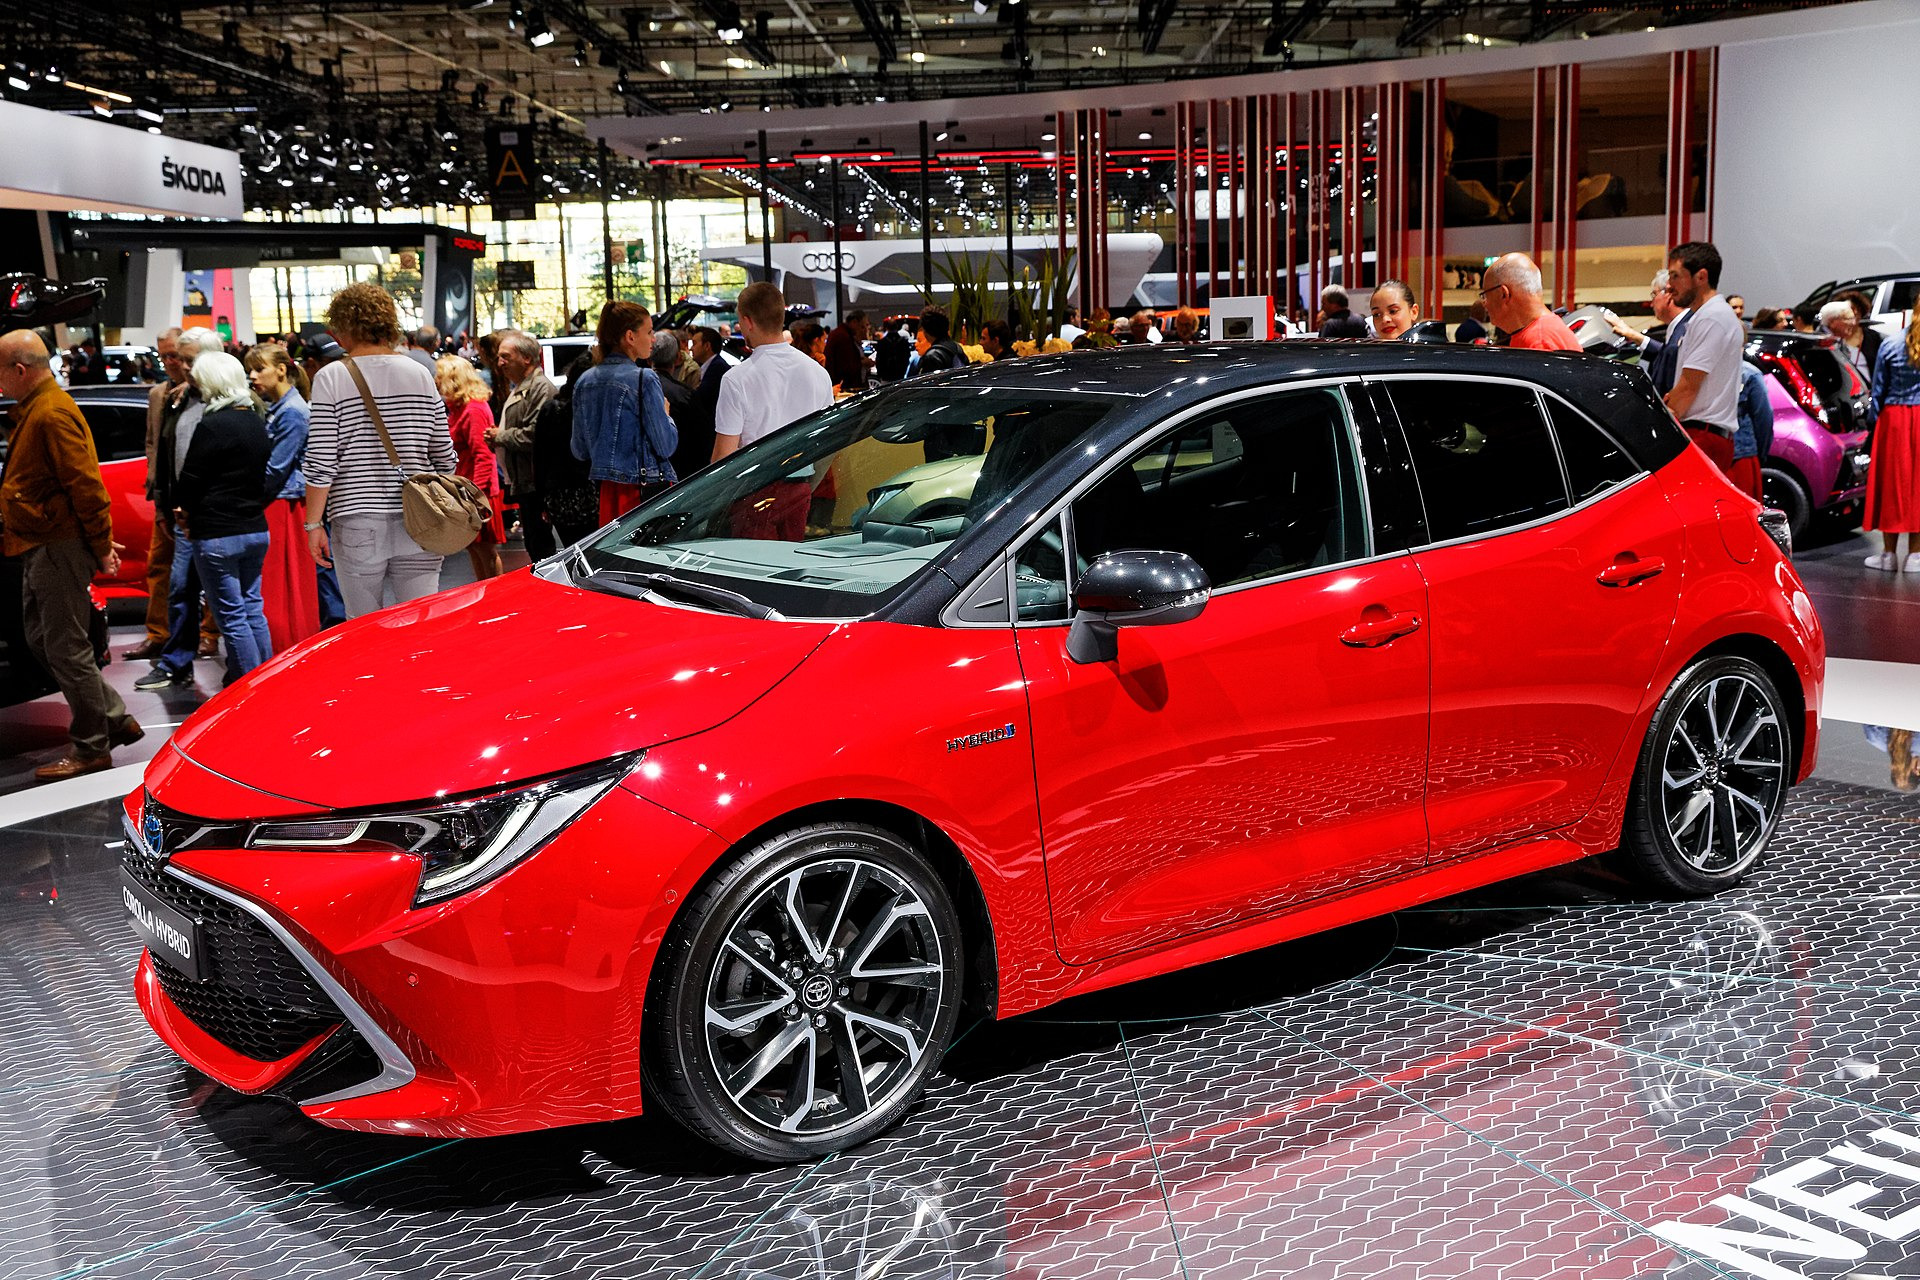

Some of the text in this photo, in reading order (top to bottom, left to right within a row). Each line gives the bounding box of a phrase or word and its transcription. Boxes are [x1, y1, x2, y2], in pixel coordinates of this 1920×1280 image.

[161, 155, 226, 197] ŠKODA
[496, 150, 528, 186] A
[945, 728, 1005, 752] HYBRID
[122, 885, 191, 960] COROLLA HYBRID
